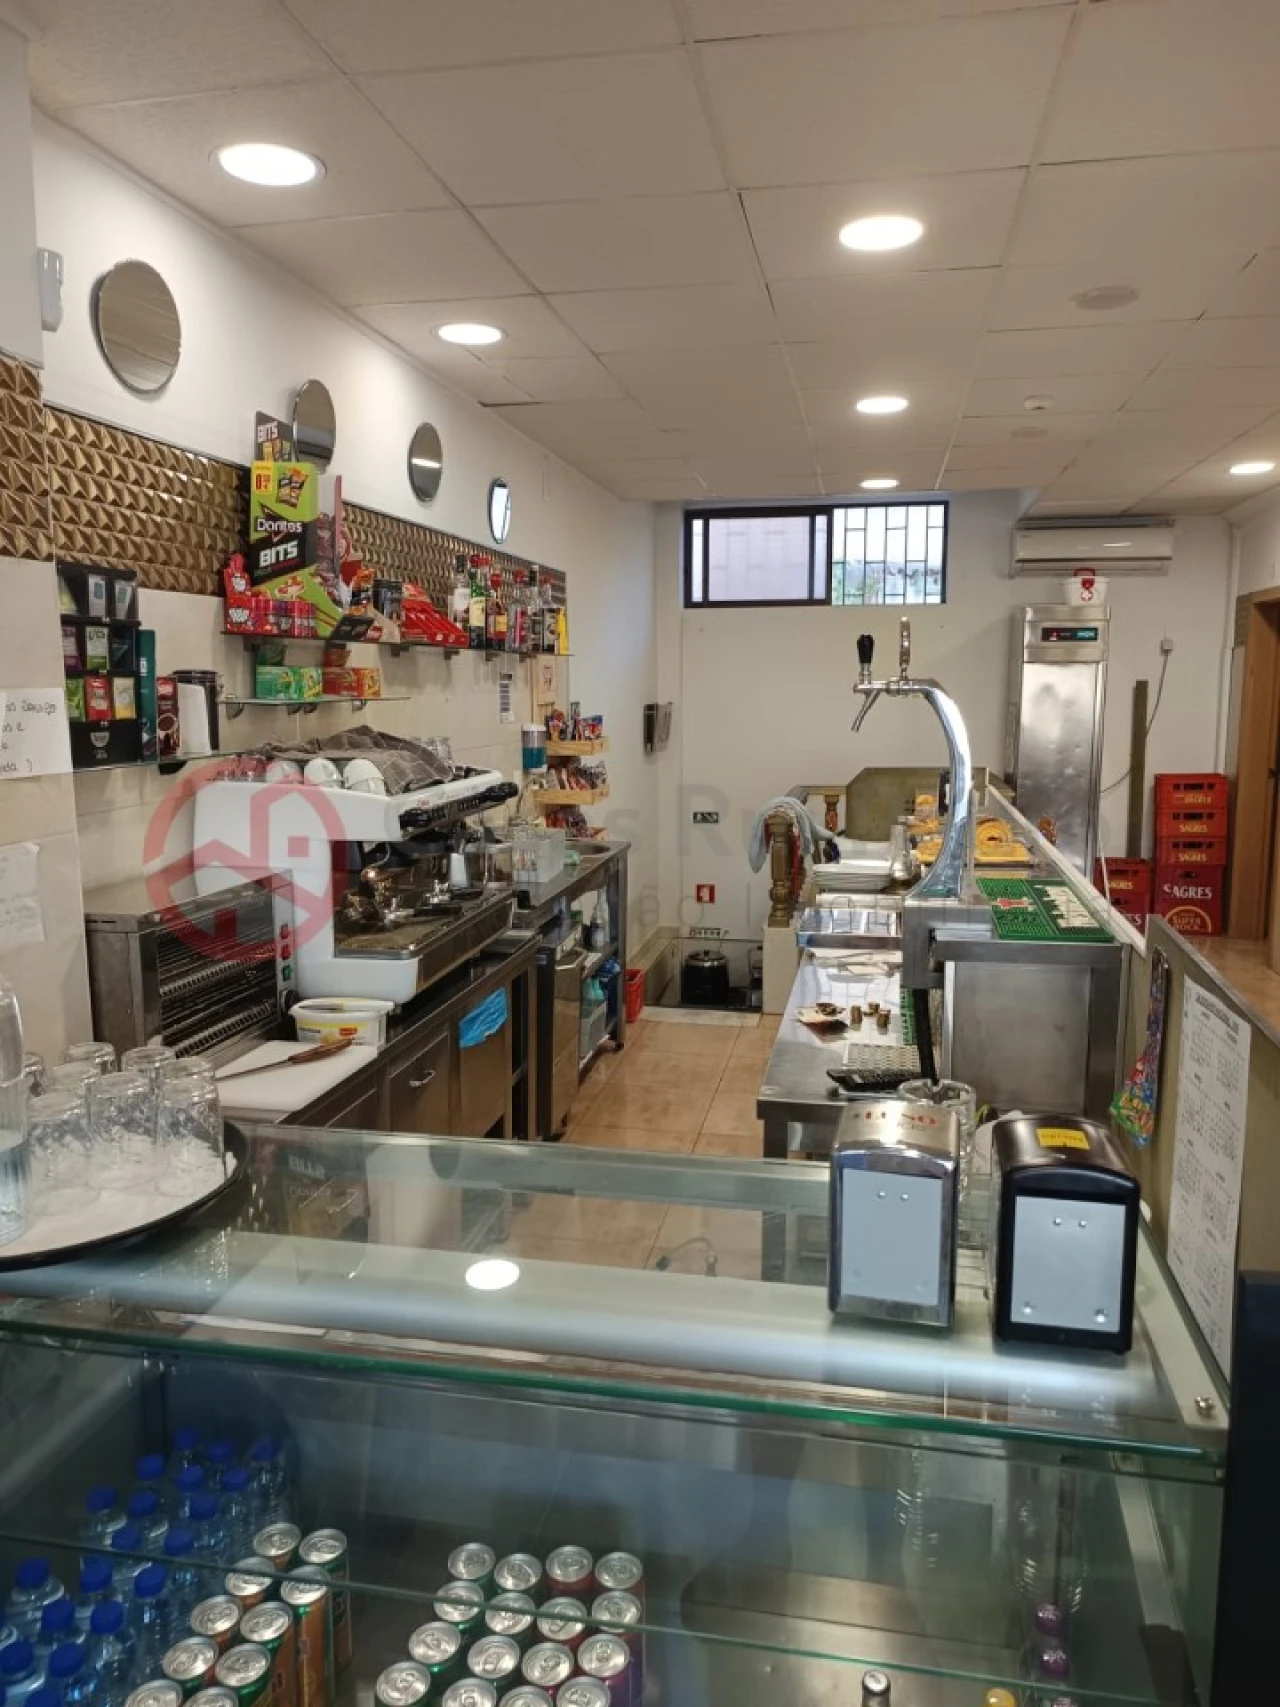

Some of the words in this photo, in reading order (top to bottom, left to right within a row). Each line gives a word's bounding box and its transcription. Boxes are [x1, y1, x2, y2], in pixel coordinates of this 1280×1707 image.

[257, 518, 303, 533] Doritos
[259, 540, 299, 568] BITS
[1179, 824, 1208, 833] SAGRES
[1163, 883, 1213, 900] SAGRES
